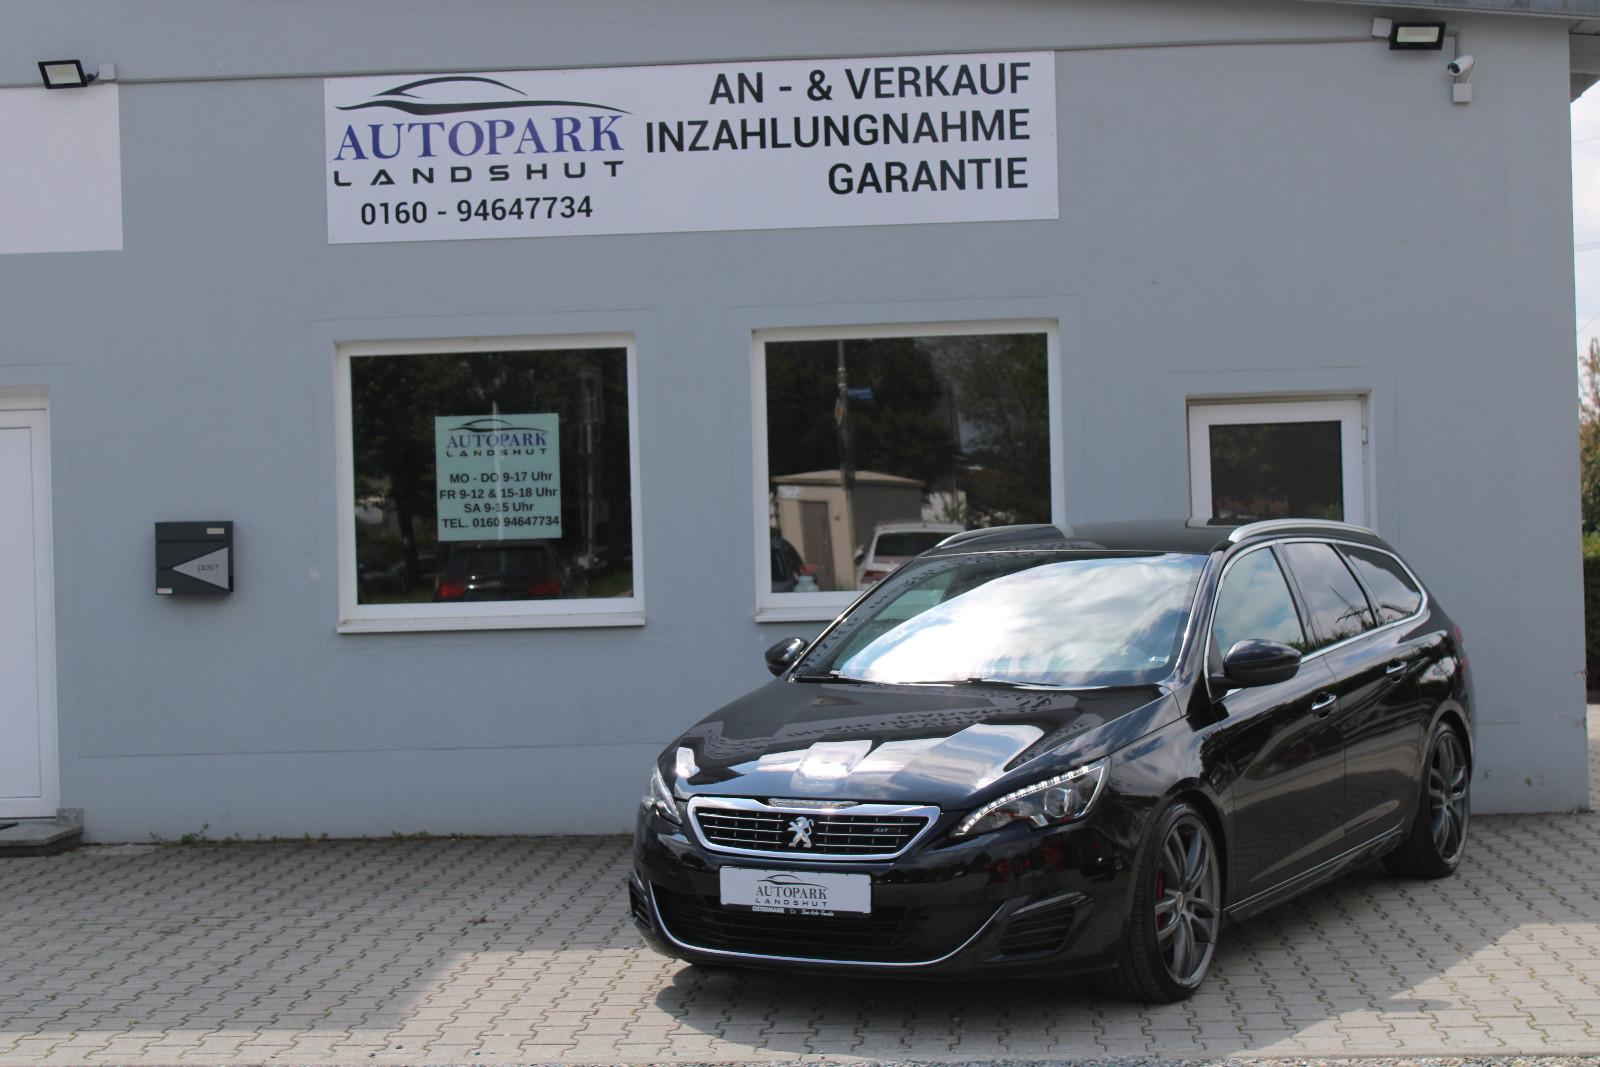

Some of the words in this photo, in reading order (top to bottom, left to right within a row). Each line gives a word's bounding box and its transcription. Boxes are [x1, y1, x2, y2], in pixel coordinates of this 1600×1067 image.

[709, 71, 764, 105] AN
[806, 69, 833, 102] &
[844, 62, 1031, 100] VERKAUF
[646, 108, 1031, 153] INZAHLUNGNAHME
[333, 115, 625, 161] AUTOPARK
[333, 160, 624, 187] LANDSHUT
[828, 156, 1028, 195] GARANTIE
[361, 201, 428, 225] 0160
[456, 196, 593, 222] 94647734
[447, 433, 547, 448] AUTOPARK
[446, 448, 547, 457] LANDSHUT
[449, 473, 470, 484] MO
[481, 473, 499, 483] DO
[502, 471, 528, 482] 9-17
[531, 472, 552, 481] Uhr
[440, 490, 456, 499] FR
[459, 488, 485, 499] 9-12
[488, 488, 497, 499] &
[501, 487, 533, 498] 15-18
[536, 487, 557, 497] Uhr
[464, 503, 481, 513] SA
[513, 502, 534, 512] Uhr
[443, 519, 469, 528] TEL.
[472, 517, 500, 528] 0160
[503, 516, 559, 527] 94647734
[756, 886, 827, 899] AUTOPARK
[756, 898, 828, 907] LANDSHUT
